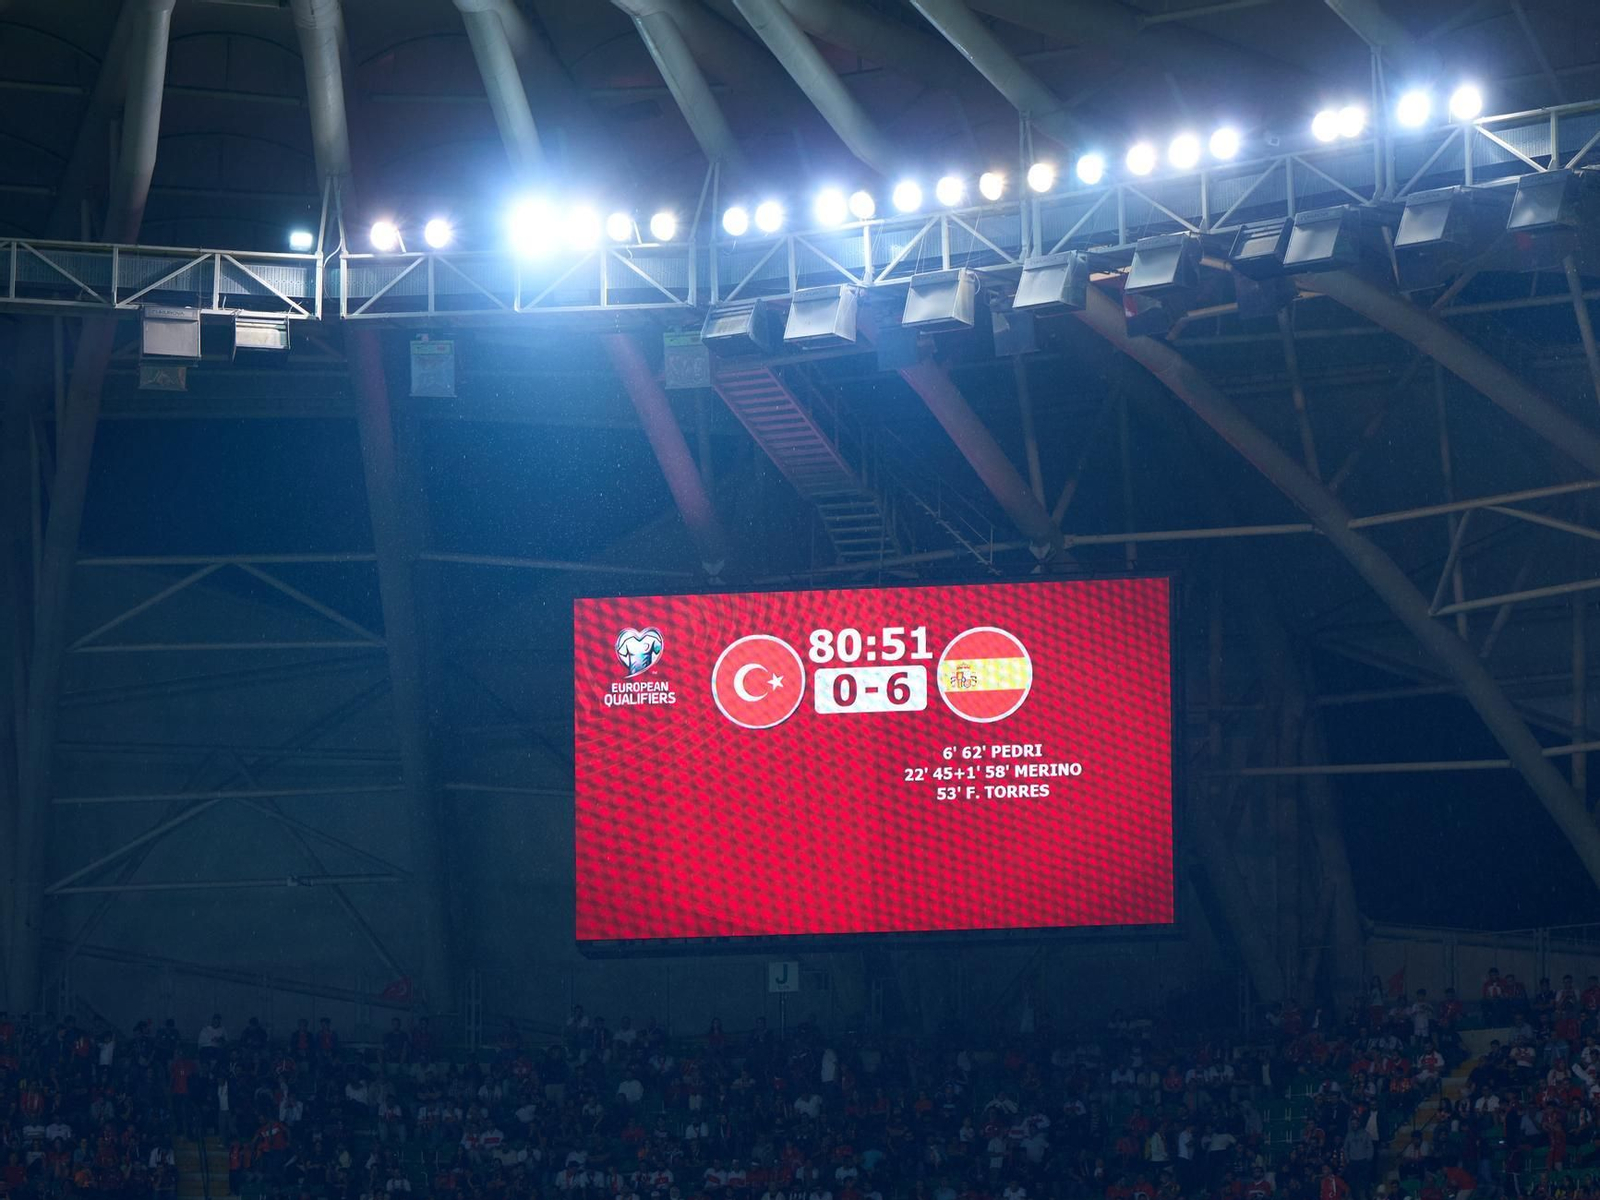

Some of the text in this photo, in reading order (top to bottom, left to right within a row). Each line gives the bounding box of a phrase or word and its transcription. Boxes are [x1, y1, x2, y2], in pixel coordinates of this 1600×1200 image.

[808, 626, 933, 663] 80:51
[611, 681, 669, 693] EUROPEAN
[604, 692, 677, 707] QUALIFIERS
[942, 743, 1043, 760] 6' 62' PEDRI
[904, 762, 1083, 781] 22' 45+1' 58' MERINO
[936, 784, 1050, 800] 53' F. TORRES
[775, 963, 788, 985] J
